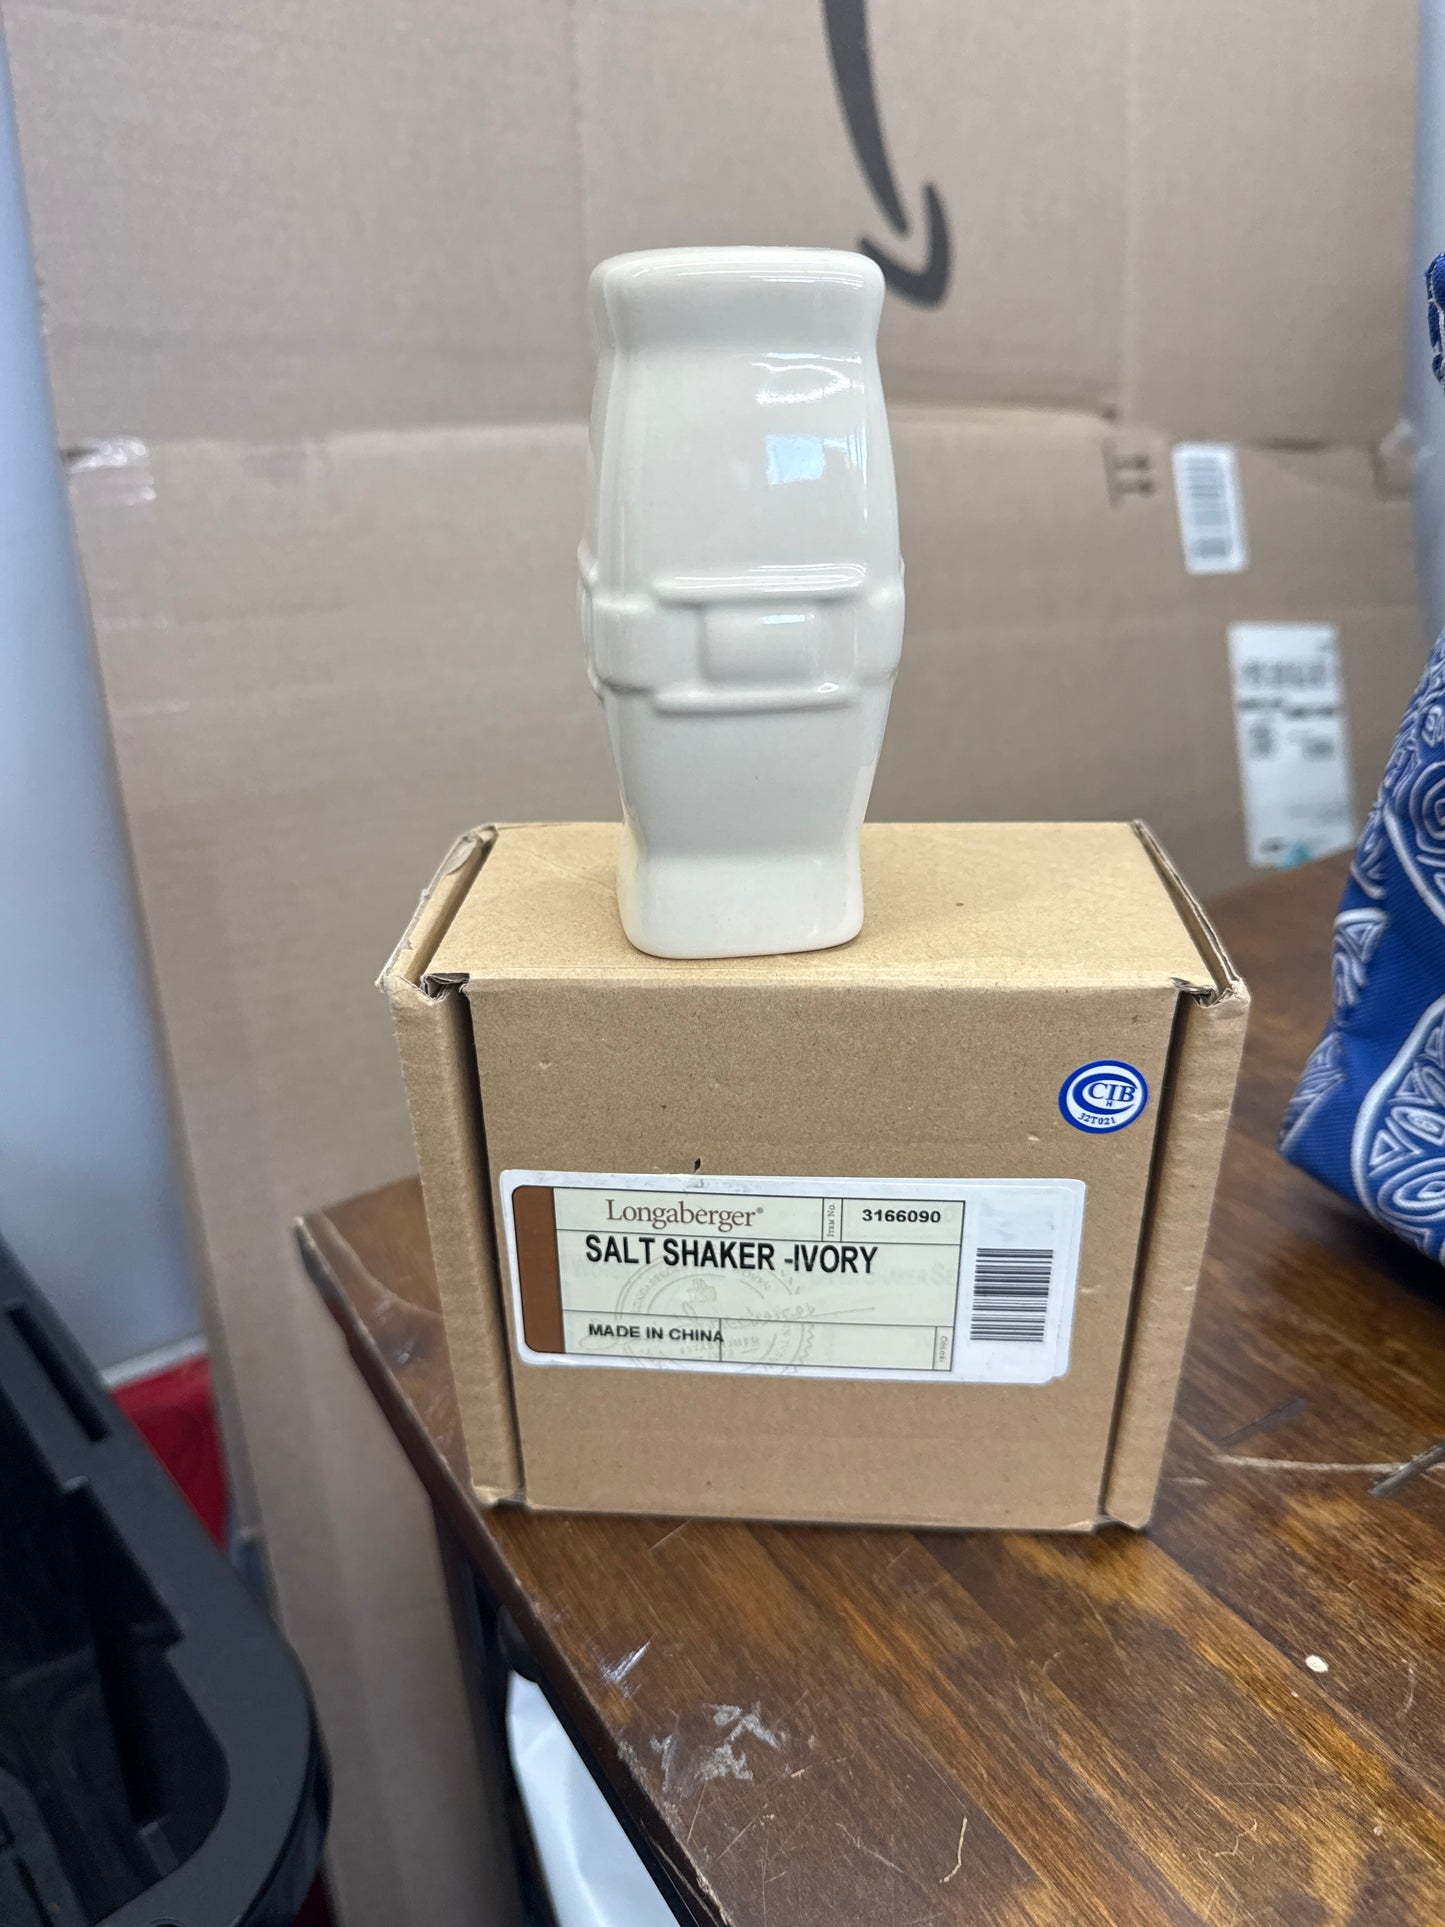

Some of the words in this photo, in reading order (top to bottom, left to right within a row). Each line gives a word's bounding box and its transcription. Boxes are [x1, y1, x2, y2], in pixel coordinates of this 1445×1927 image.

[1088, 1082, 1136, 1102] CIB
[861, 1208, 941, 1223] 3166090
[586, 1234, 656, 1264] SALT
[663, 1237, 775, 1271] SHAKER
[588, 1323, 641, 1338] MADE
[646, 1325, 664, 1340] IN
[668, 1327, 724, 1343] CHINA
